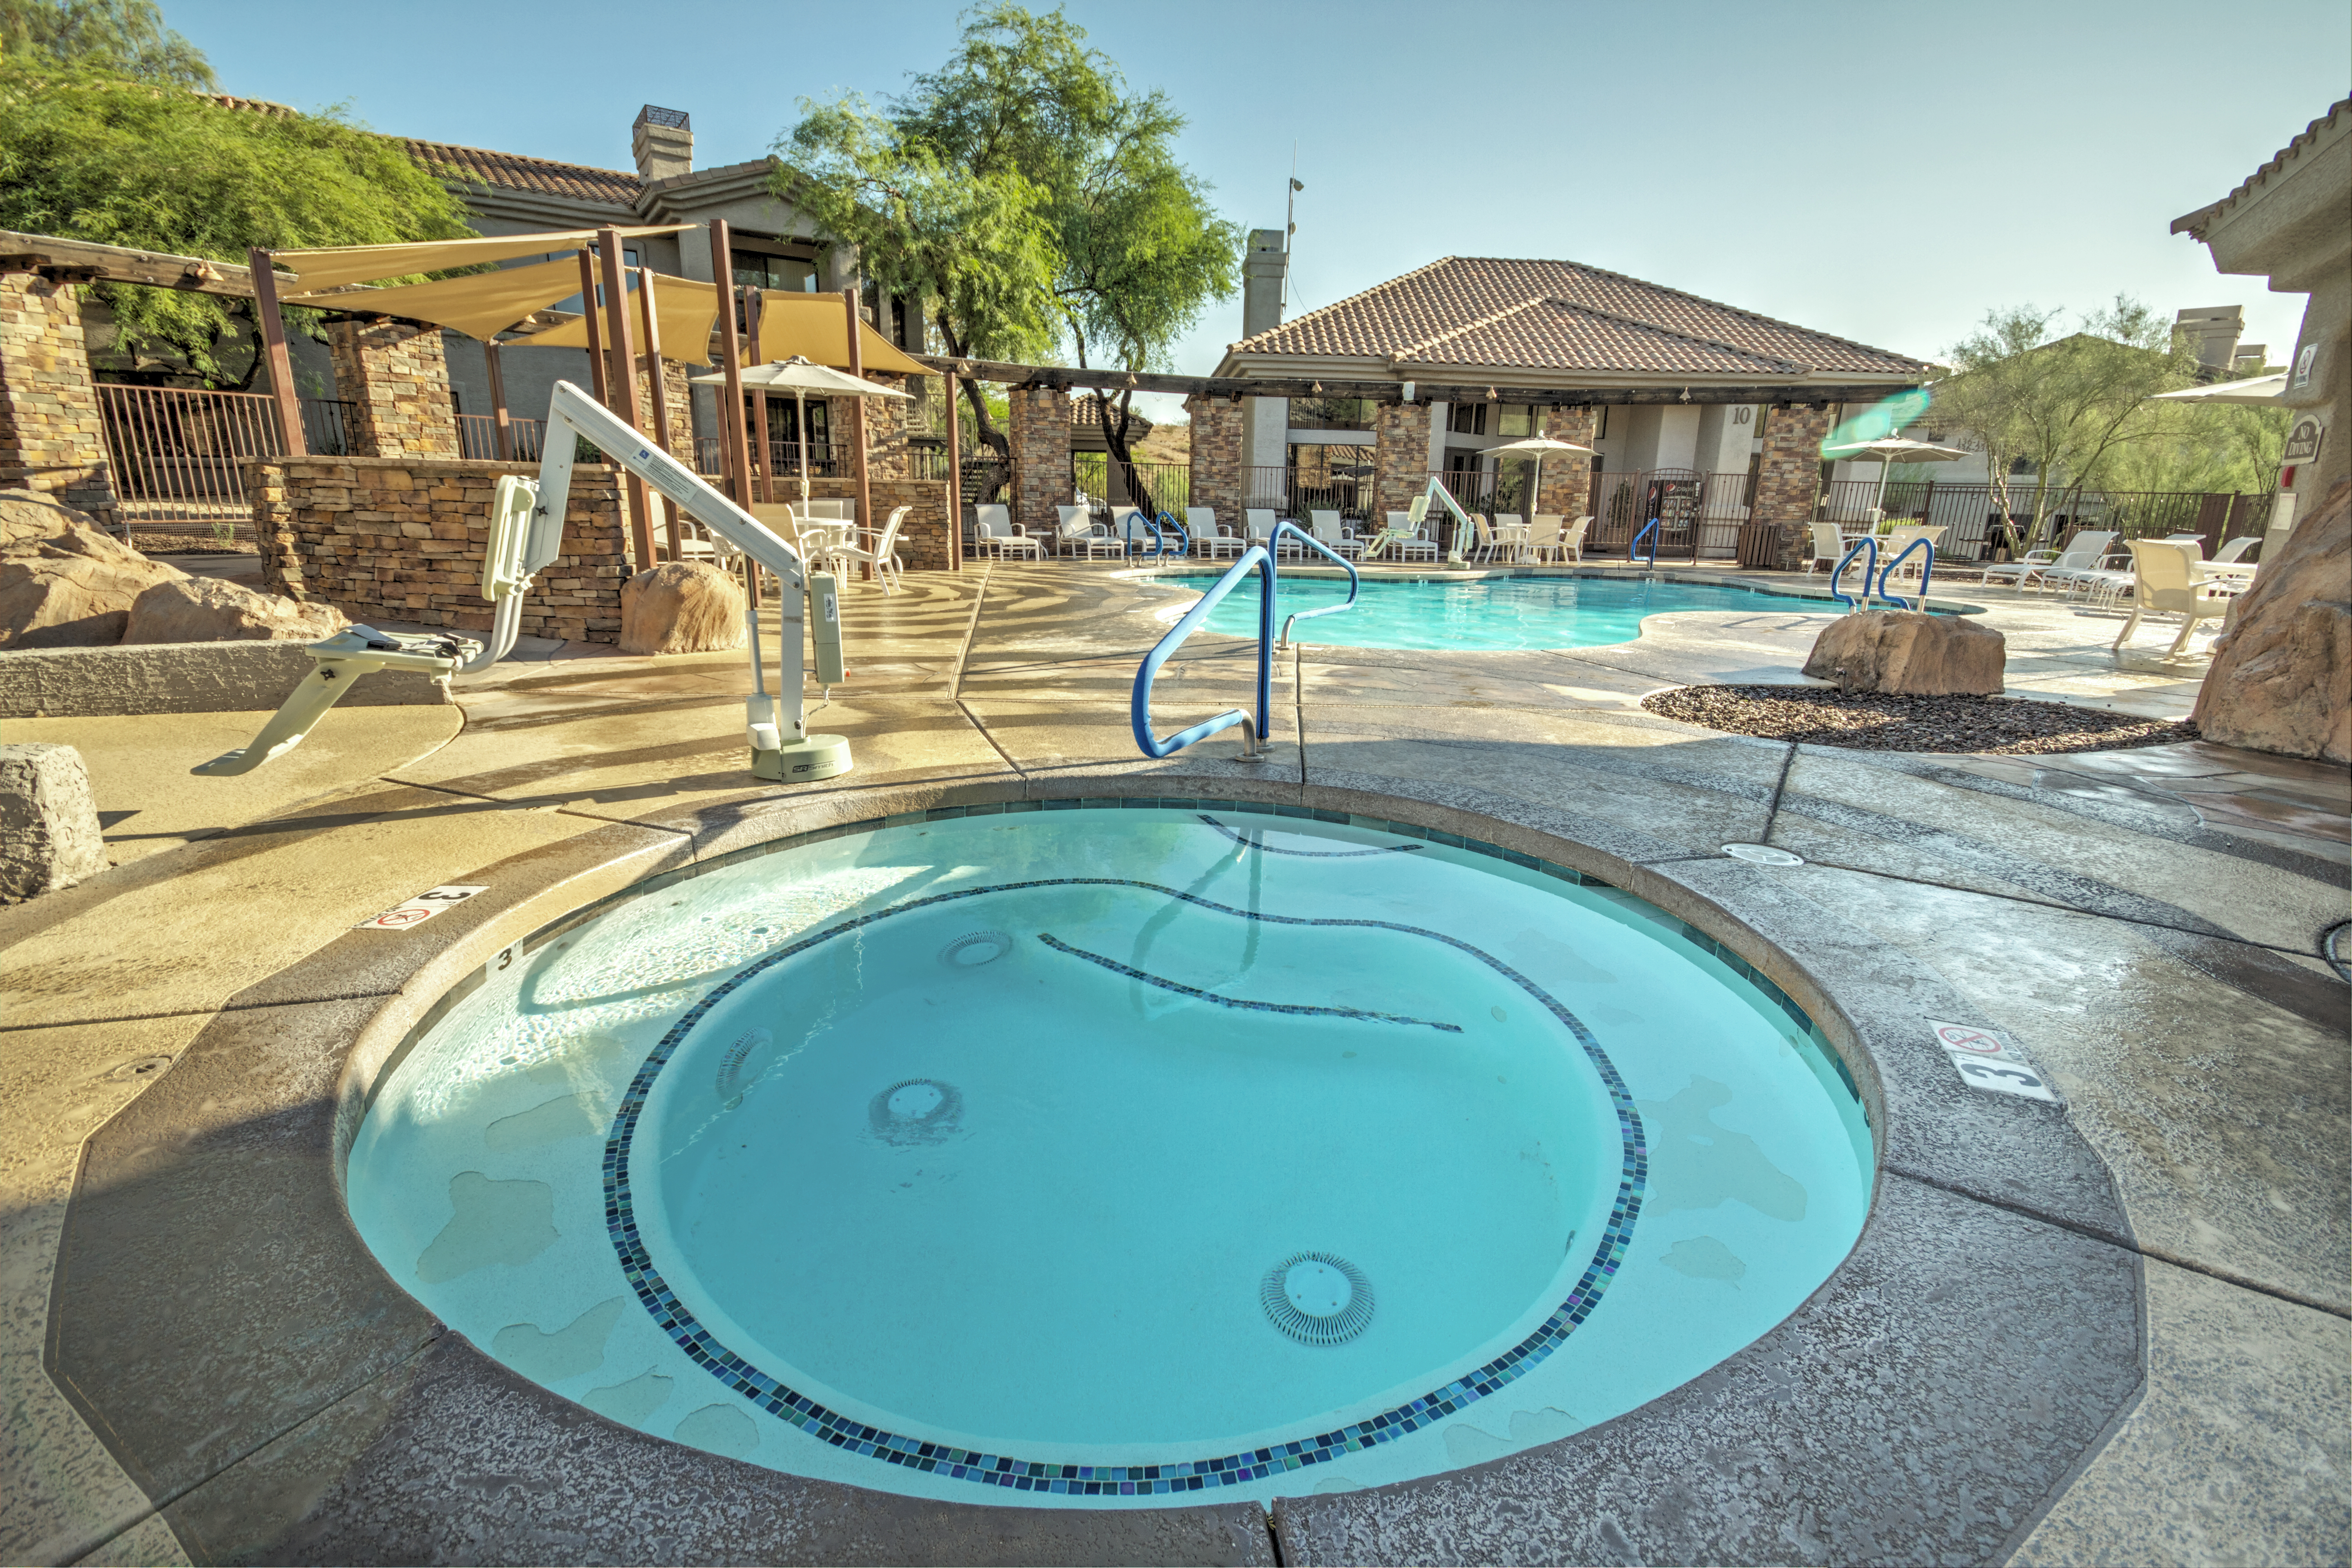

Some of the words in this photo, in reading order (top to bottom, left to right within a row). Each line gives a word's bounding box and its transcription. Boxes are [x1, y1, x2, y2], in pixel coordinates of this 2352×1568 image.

[1733, 407, 1751, 424] 10
[2298, 426, 2310, 440] NO
[2288, 441, 2313, 456] DIVING
[353, 913, 388, 927] DIVING
[498, 947, 512, 970] 3
[1992, 1031, 2019, 1052] DIVING
[1953, 1053, 1974, 1062] FT
[2008, 1052, 2026, 1062] NO
[1960, 1063, 2042, 1087] 3
